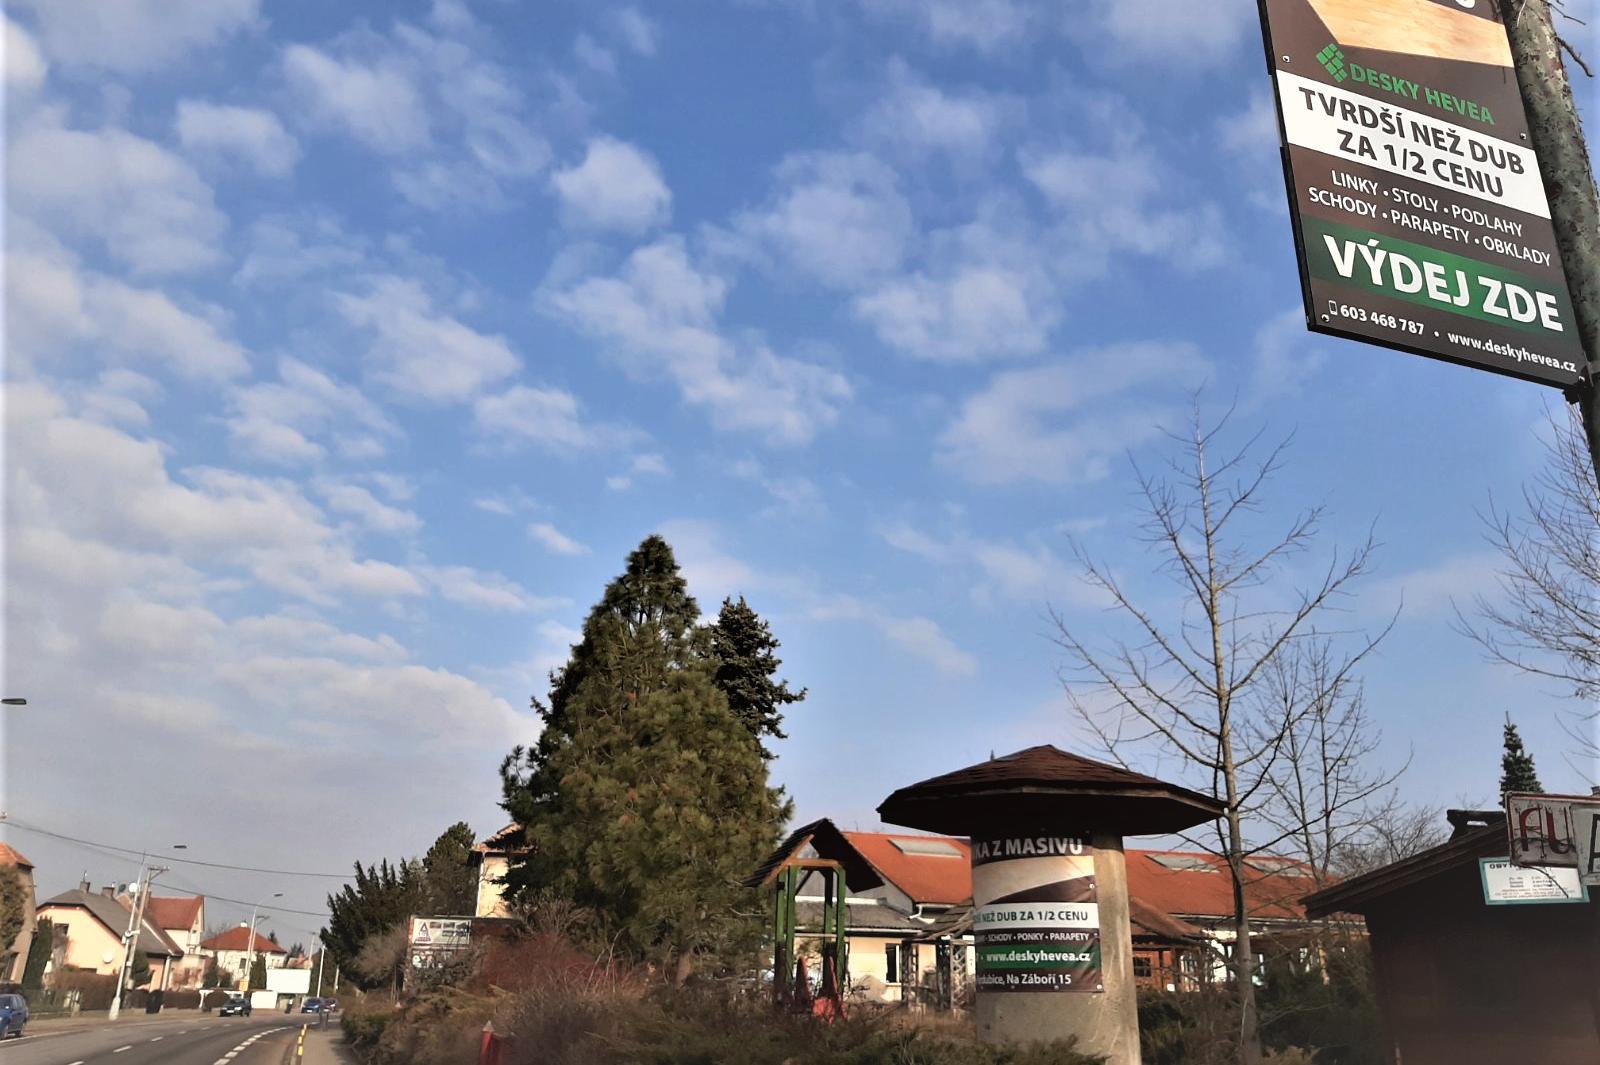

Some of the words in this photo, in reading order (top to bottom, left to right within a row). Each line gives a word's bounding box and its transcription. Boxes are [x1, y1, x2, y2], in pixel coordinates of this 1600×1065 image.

[1350, 63, 1419, 100] DESKY
[1425, 87, 1494, 125] HEVEA
[1299, 86, 1405, 138] TVRDŠÍ
[1411, 120, 1464, 157] NEŽ
[1468, 144, 1524, 175] DUB
[1337, 129, 1377, 161] ZA
[1384, 143, 1427, 175] 1/2
[1432, 159, 1503, 198] CENU
[1308, 186, 1377, 219] SCHODY
[1390, 209, 1469, 244] PARAPETY
[1483, 235, 1551, 267] OBKLADY
[1331, 170, 1378, 196] LINKY
[1391, 187, 1439, 214] STOLY
[1452, 204, 1523, 238] PODLAHY
[1322, 234, 1470, 308] VÝDEJ
[1477, 275, 1564, 332] ZDE
[1340, 304, 1367, 322] 603
[1370, 311, 1397, 329] 468
[1398, 318, 1425, 336] 787
[1447, 331, 1577, 373] www.deskyhevea.cz
[992, 840, 1002, 856] Z
[1005, 837, 1083, 855] MASIVU
[996, 911, 1017, 922] DUB
[1020, 911, 1034, 921] ZA
[1038, 910, 1055, 921] 1/2
[1058, 910, 1088, 921] CENU
[1017, 932, 1044, 941] PONKY
[1050, 932, 1089, 941] PARAPETY
[986, 950, 1091, 964] www.deskyhevea.cz
[1006, 974, 1020, 984] Na
[1021, 973, 1056, 985] Záboří
[1059, 974, 1072, 984] 15
